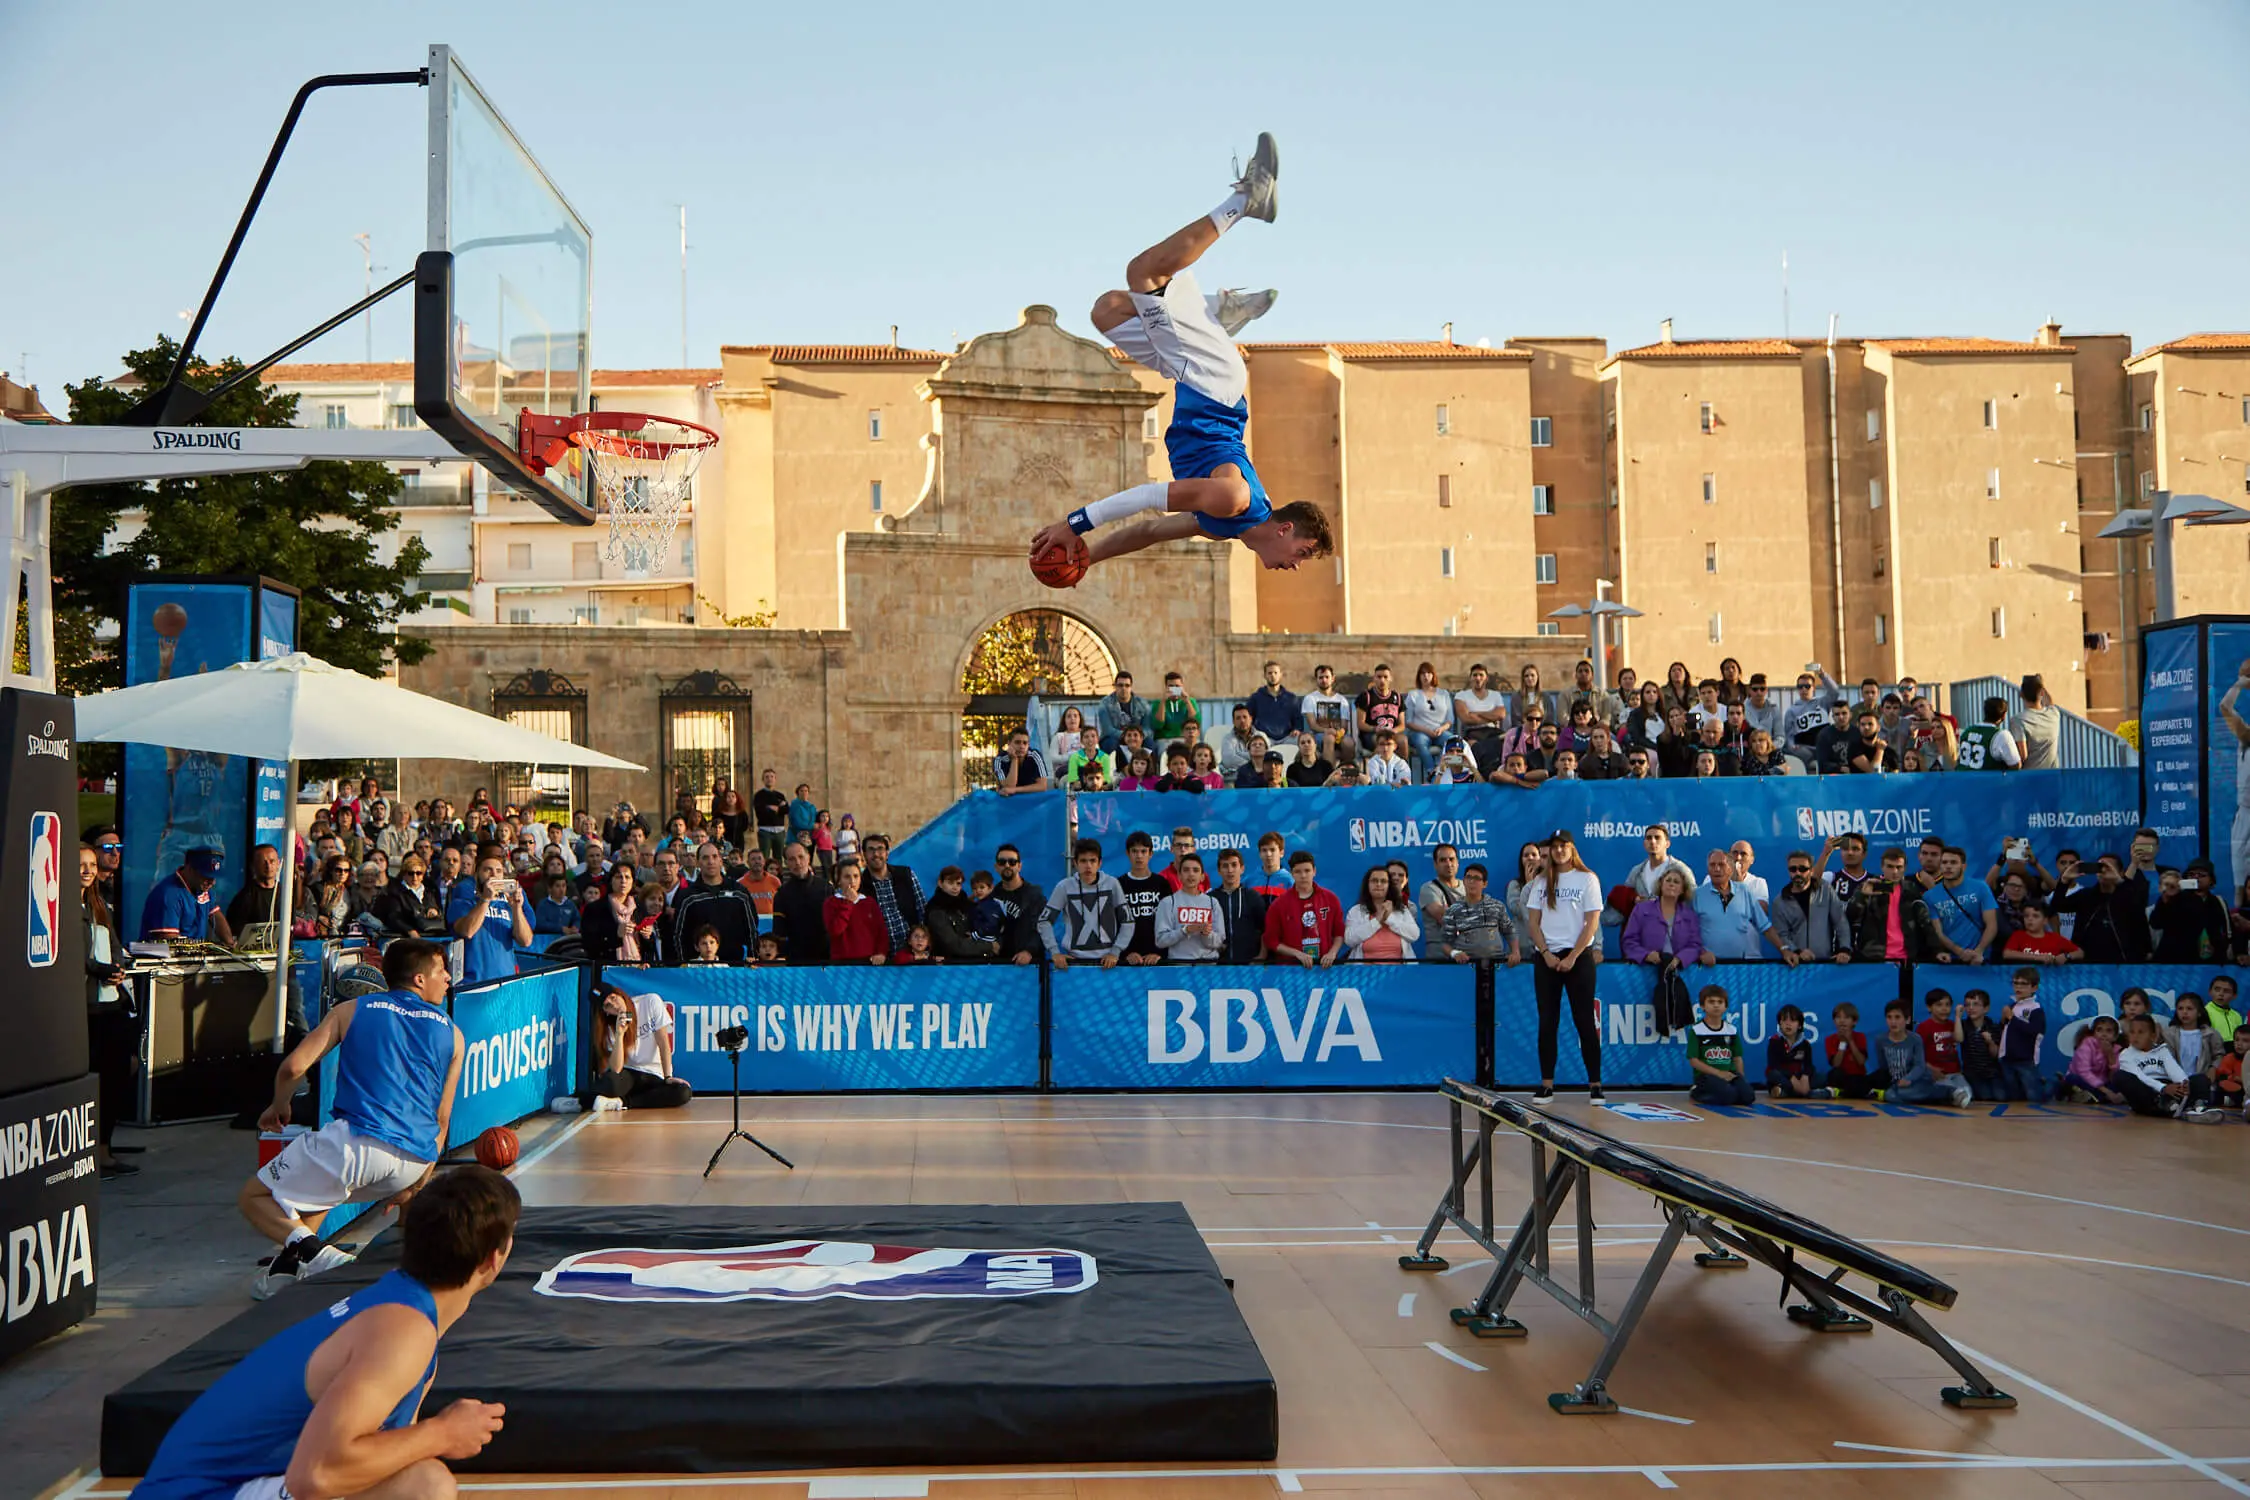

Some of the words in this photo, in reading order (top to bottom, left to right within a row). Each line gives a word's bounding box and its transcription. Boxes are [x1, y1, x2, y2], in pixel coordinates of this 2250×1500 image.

[153, 431, 241, 451] SPALDING
[28, 734, 69, 760] SPALDING
[1960, 741, 1986, 769] 33
[1816, 810, 1869, 836] NBA
[1869, 808, 1932, 834] ZONE
[2028, 810, 2140, 828] #NBAZoneBBVA
[1368, 821, 1421, 848] NBA
[1423, 819, 1487, 846] ZONE
[1459, 848, 1488, 859] BBVA
[1180, 908, 1211, 923] OBEY
[32, 935, 49, 956] NBA
[358, 967, 378, 980] NBA
[681, 1005, 749, 1053] THIS
[757, 1004, 786, 1052] IS
[793, 1004, 862, 1051] WHY
[869, 1004, 914, 1050] WE
[922, 1003, 993, 1050] PLAY
[1148, 988, 1383, 1064] BBVA
[1693, 1103, 1972, 1119] NBA
[0, 1118, 44, 1180] NBA
[45, 1101, 96, 1163] ZONE
[74, 1156, 95, 1179] BBVA
[986, 1255, 1054, 1289] NBA
